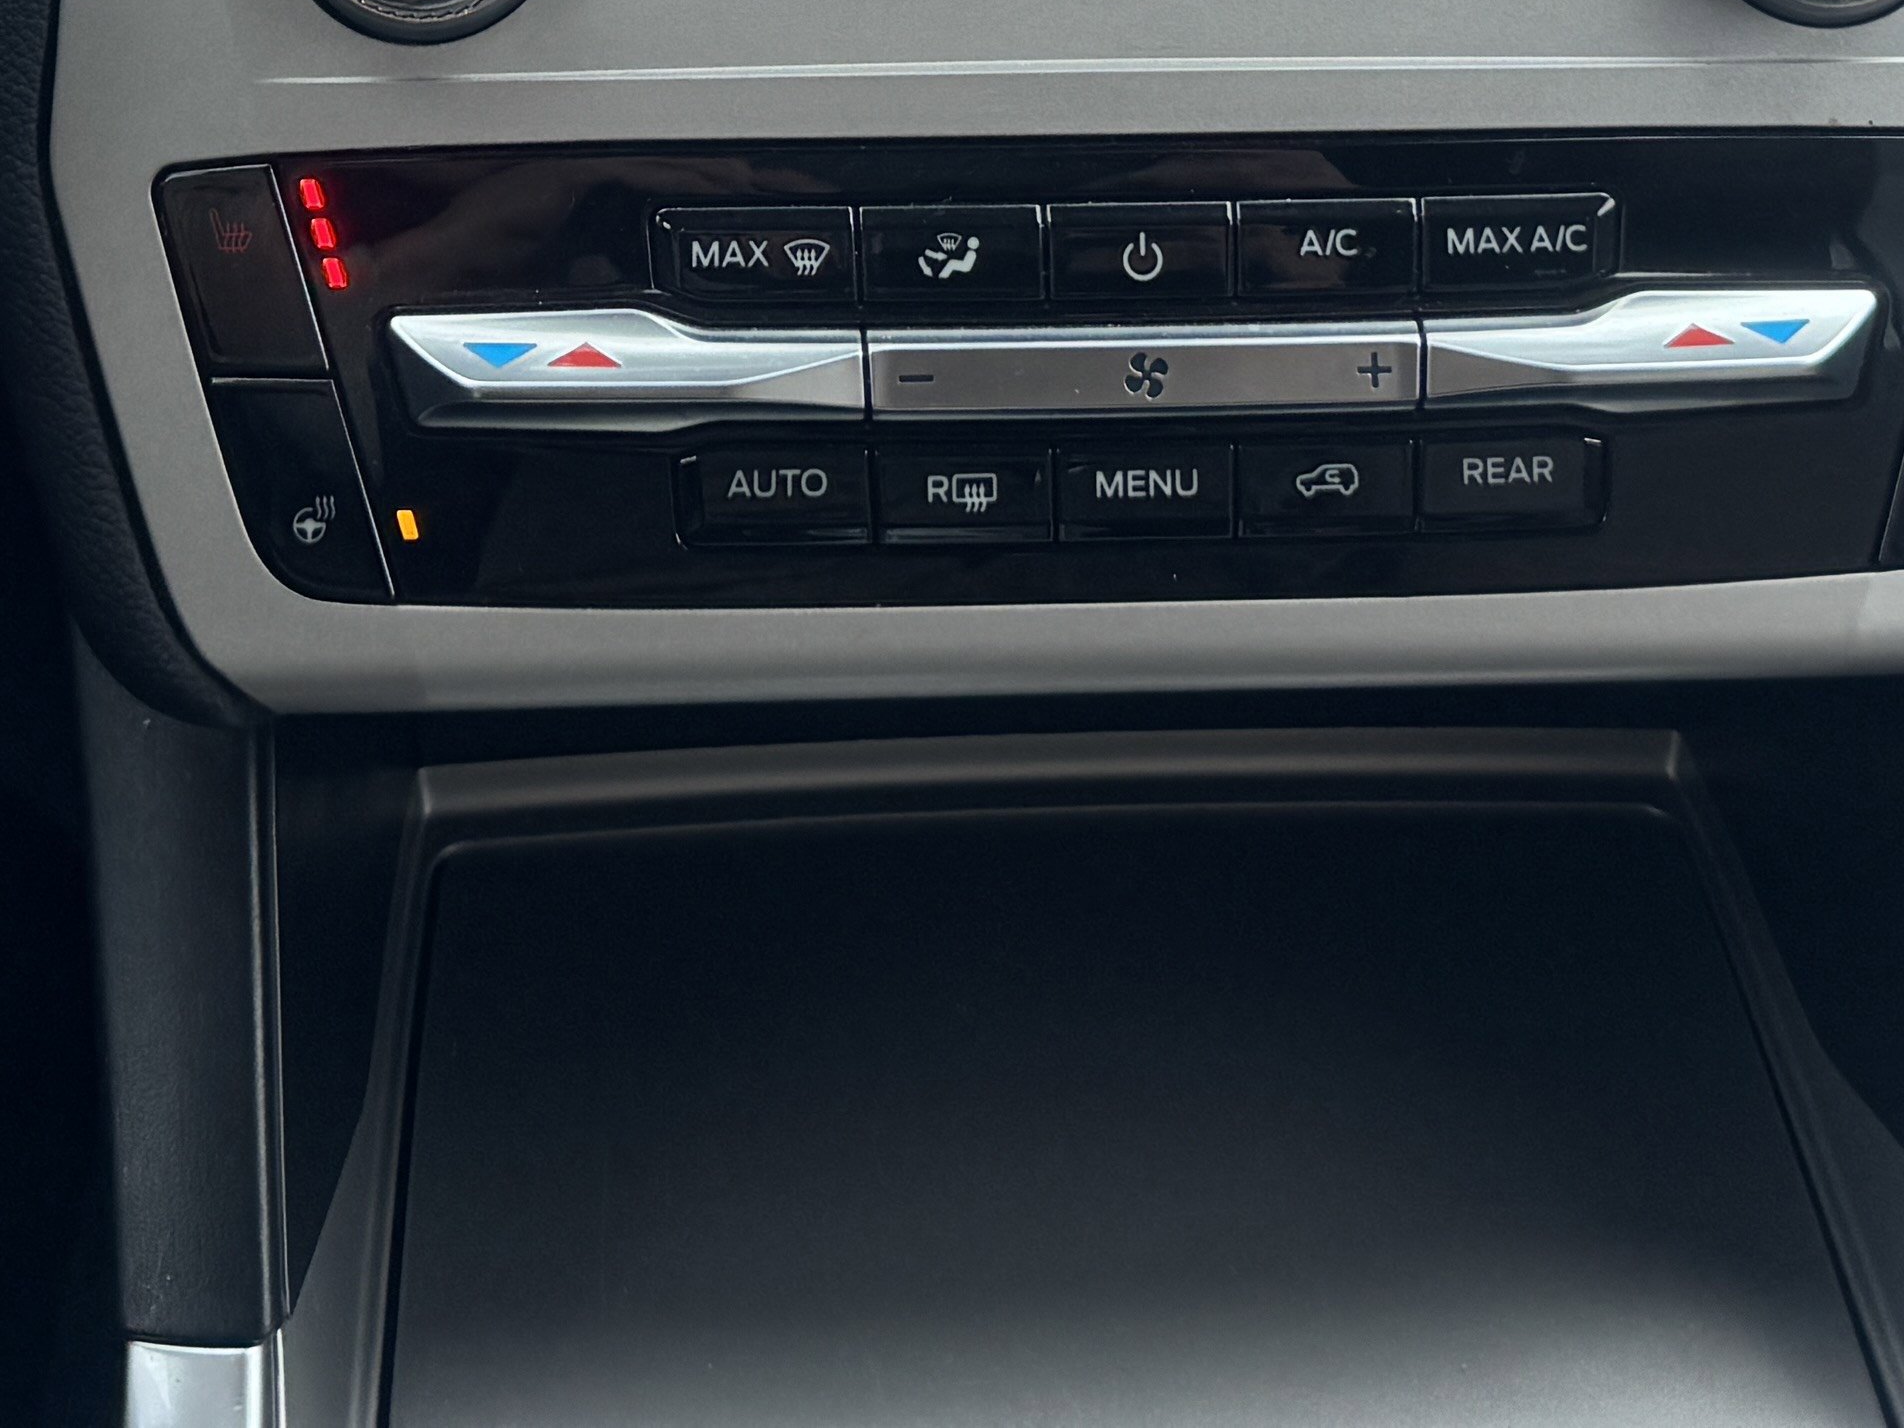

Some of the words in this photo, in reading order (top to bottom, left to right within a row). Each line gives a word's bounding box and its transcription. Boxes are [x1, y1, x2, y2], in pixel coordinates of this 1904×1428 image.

[691, 240, 769, 268] MAX
[1300, 228, 1358, 257] A/C
[1446, 226, 1523, 255] MAX
[1530, 224, 1588, 252] A/C
[727, 468, 828, 498] AUTO
[1095, 468, 1198, 498] MENU
[1462, 455, 1554, 485] REAR
[927, 475, 949, 503] R
